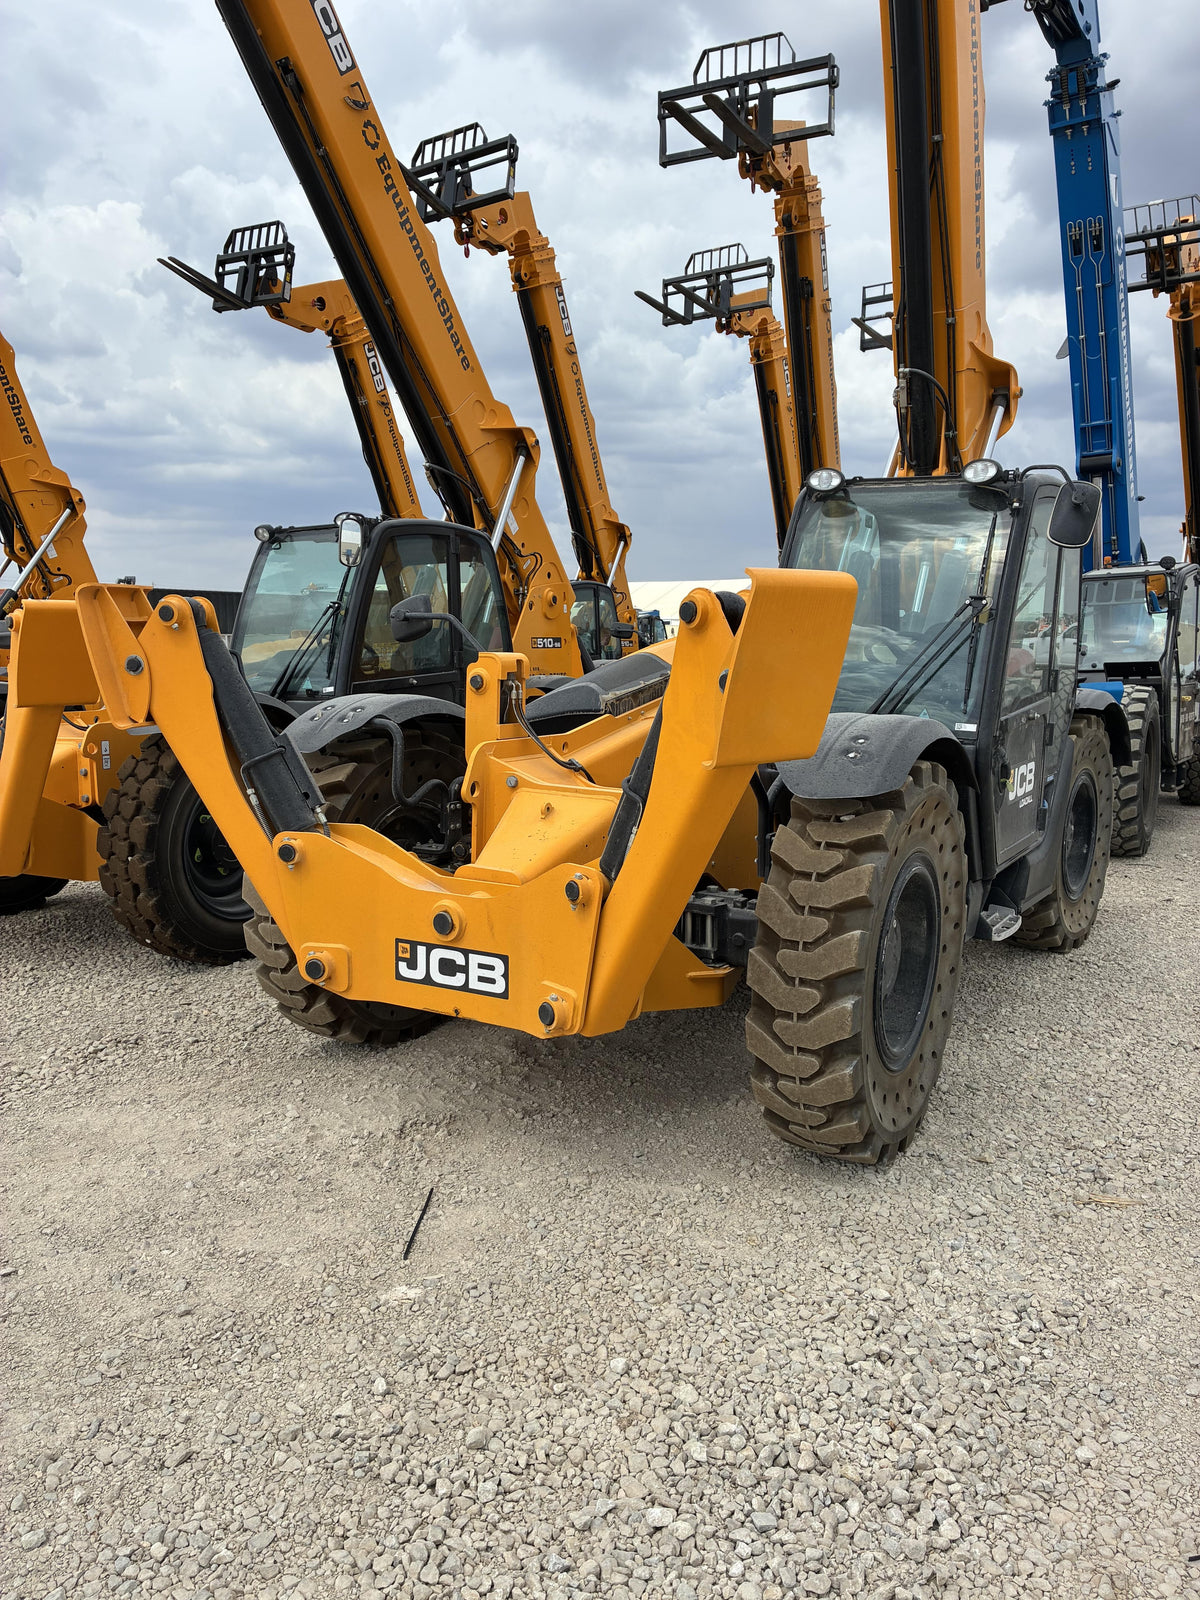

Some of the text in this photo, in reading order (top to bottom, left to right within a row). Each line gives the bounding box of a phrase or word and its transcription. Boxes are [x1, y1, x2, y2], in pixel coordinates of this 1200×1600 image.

[313, 0, 353, 72] CB
[375, 152, 470, 371] EquipmentShare
[556, 286, 572, 337] JCB
[0, 360, 33, 446] entShare
[363, 342, 386, 392] JCB
[386, 417, 415, 505] EquipmentShare
[574, 377, 603, 492] EquipmentShare
[1009, 762, 1035, 800] JCB
[398, 944, 507, 994] JCB
